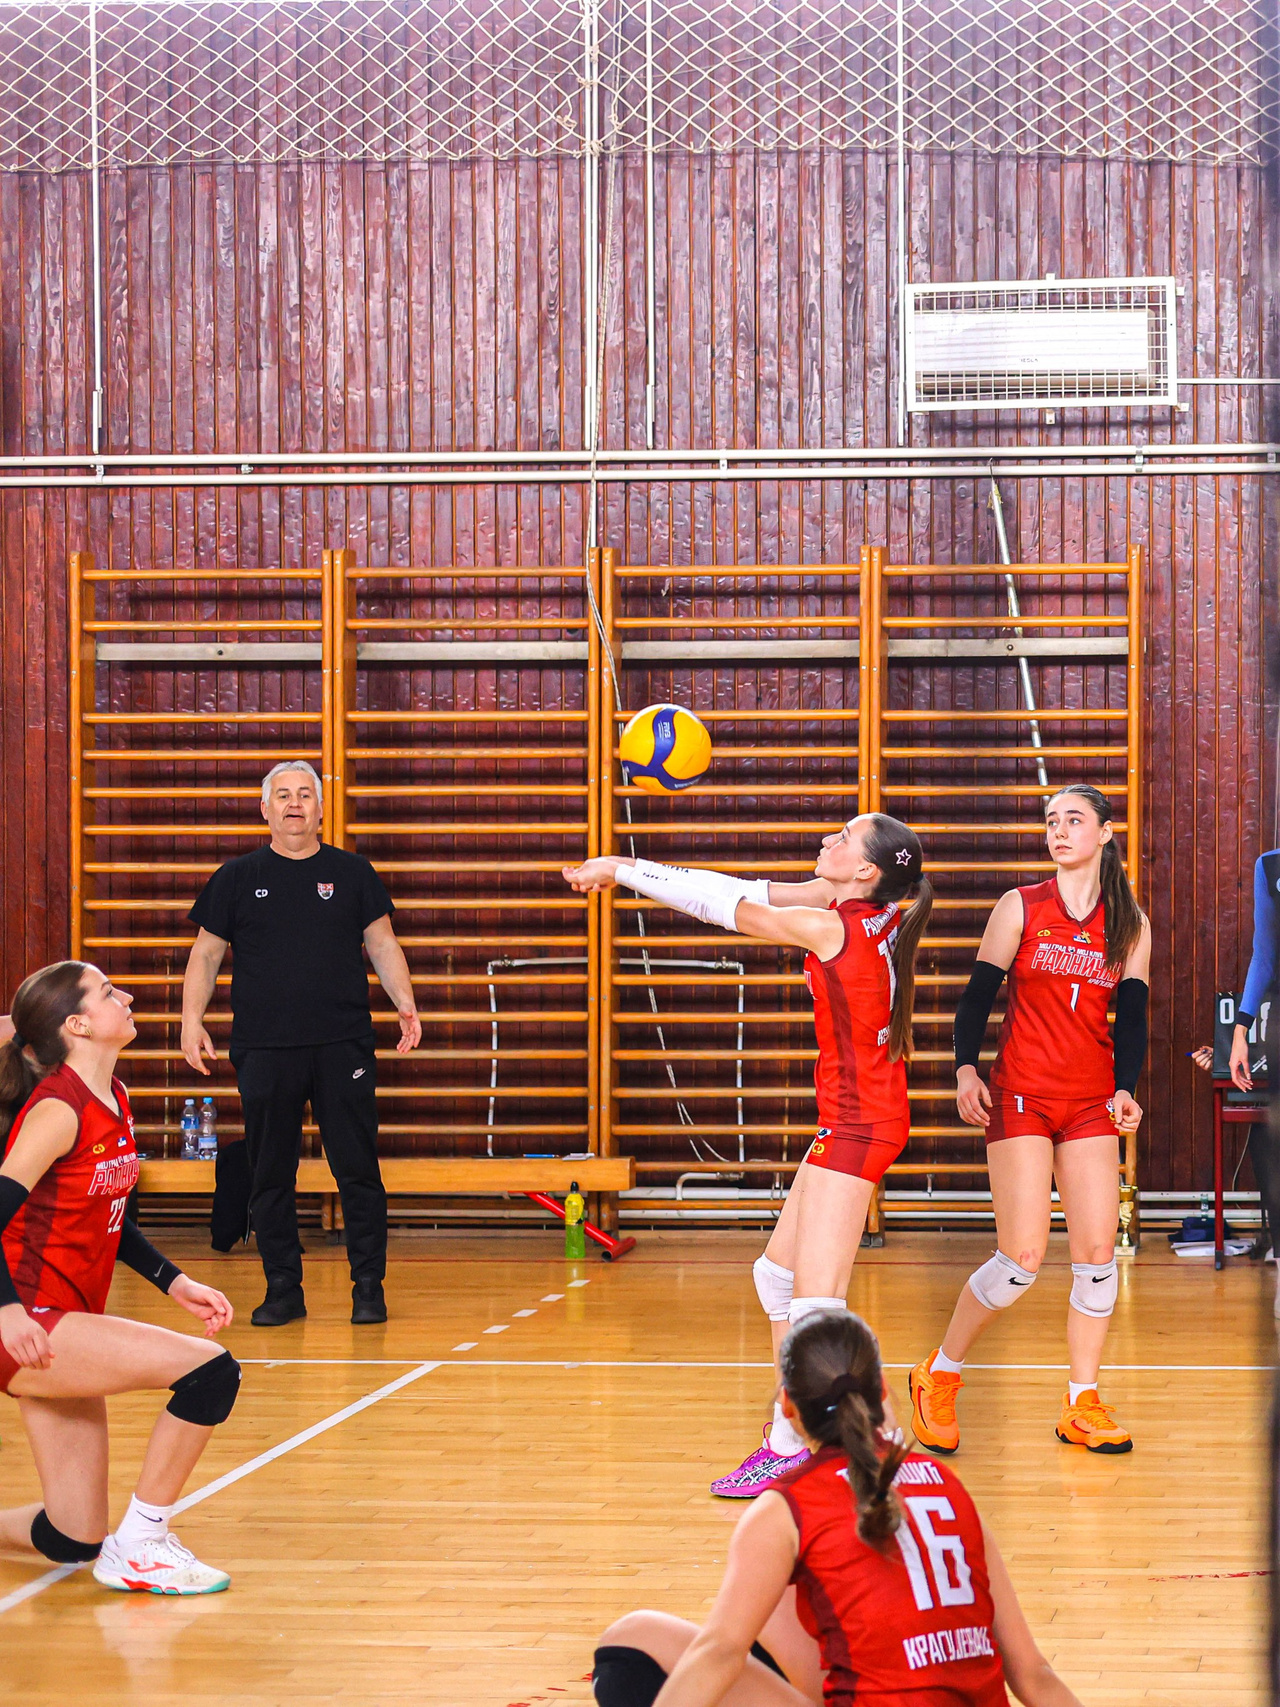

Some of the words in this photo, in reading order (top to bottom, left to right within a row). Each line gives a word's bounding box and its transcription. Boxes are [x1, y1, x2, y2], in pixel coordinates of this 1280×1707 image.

[255, 888, 269, 898] CD
[1070, 982, 1080, 1013] 1
[1220, 998, 1235, 1025] 0
[1013, 1094, 1025, 1113] 1
[894, 1495, 976, 1612] 16
